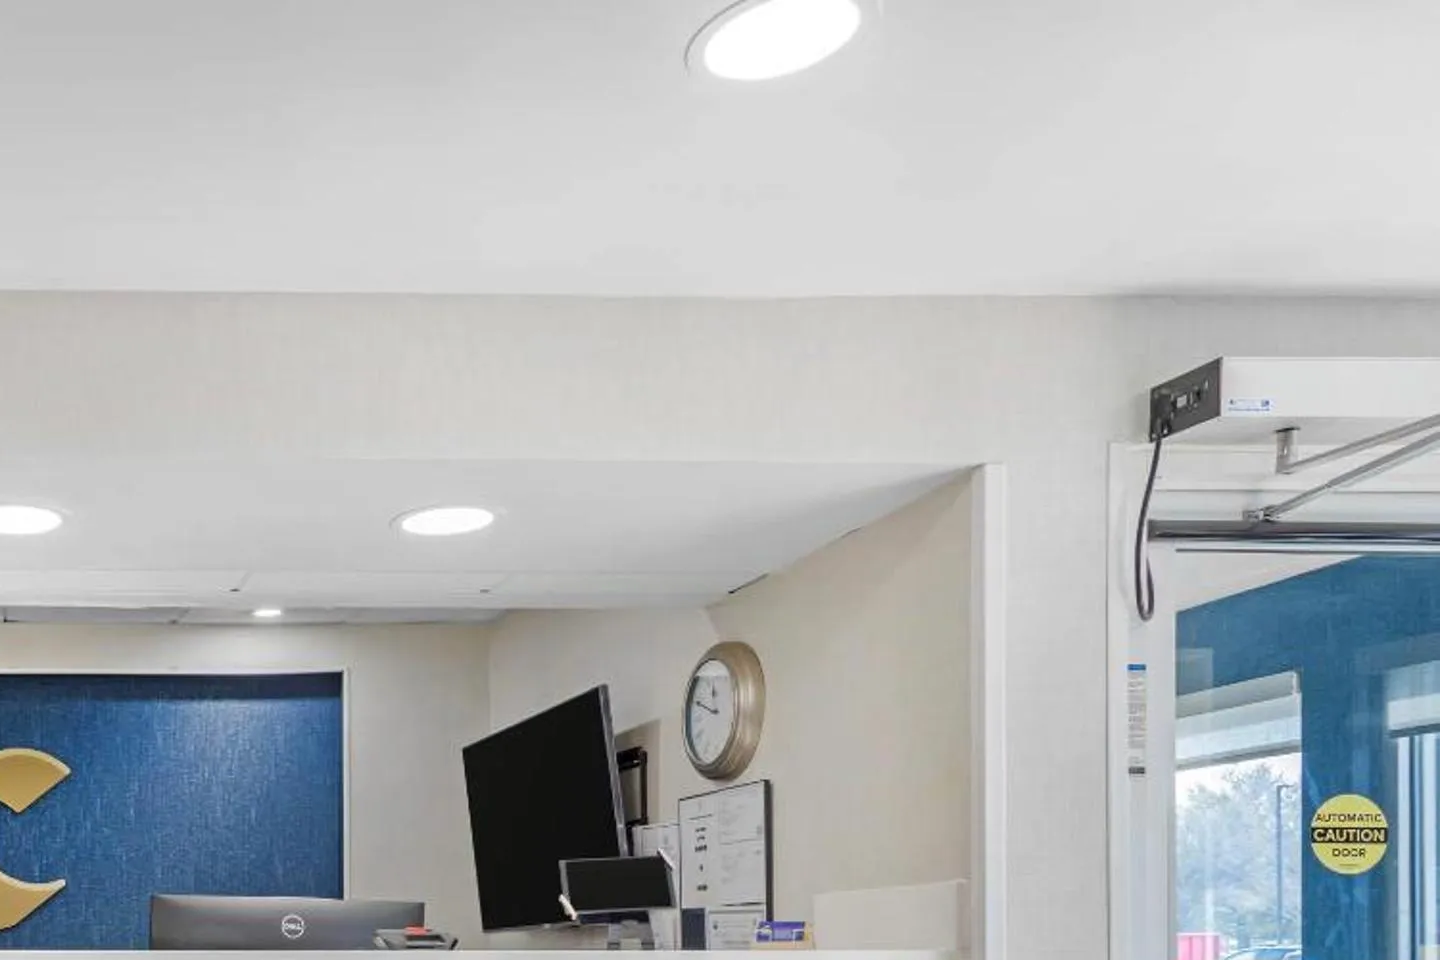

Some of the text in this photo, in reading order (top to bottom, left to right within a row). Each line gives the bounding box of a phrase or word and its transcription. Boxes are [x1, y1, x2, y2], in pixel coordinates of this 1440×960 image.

[1316, 813, 1383, 823] AUTOMATIC
[1312, 828, 1385, 842] CAUTION
[1332, 847, 1366, 858] DOOR
